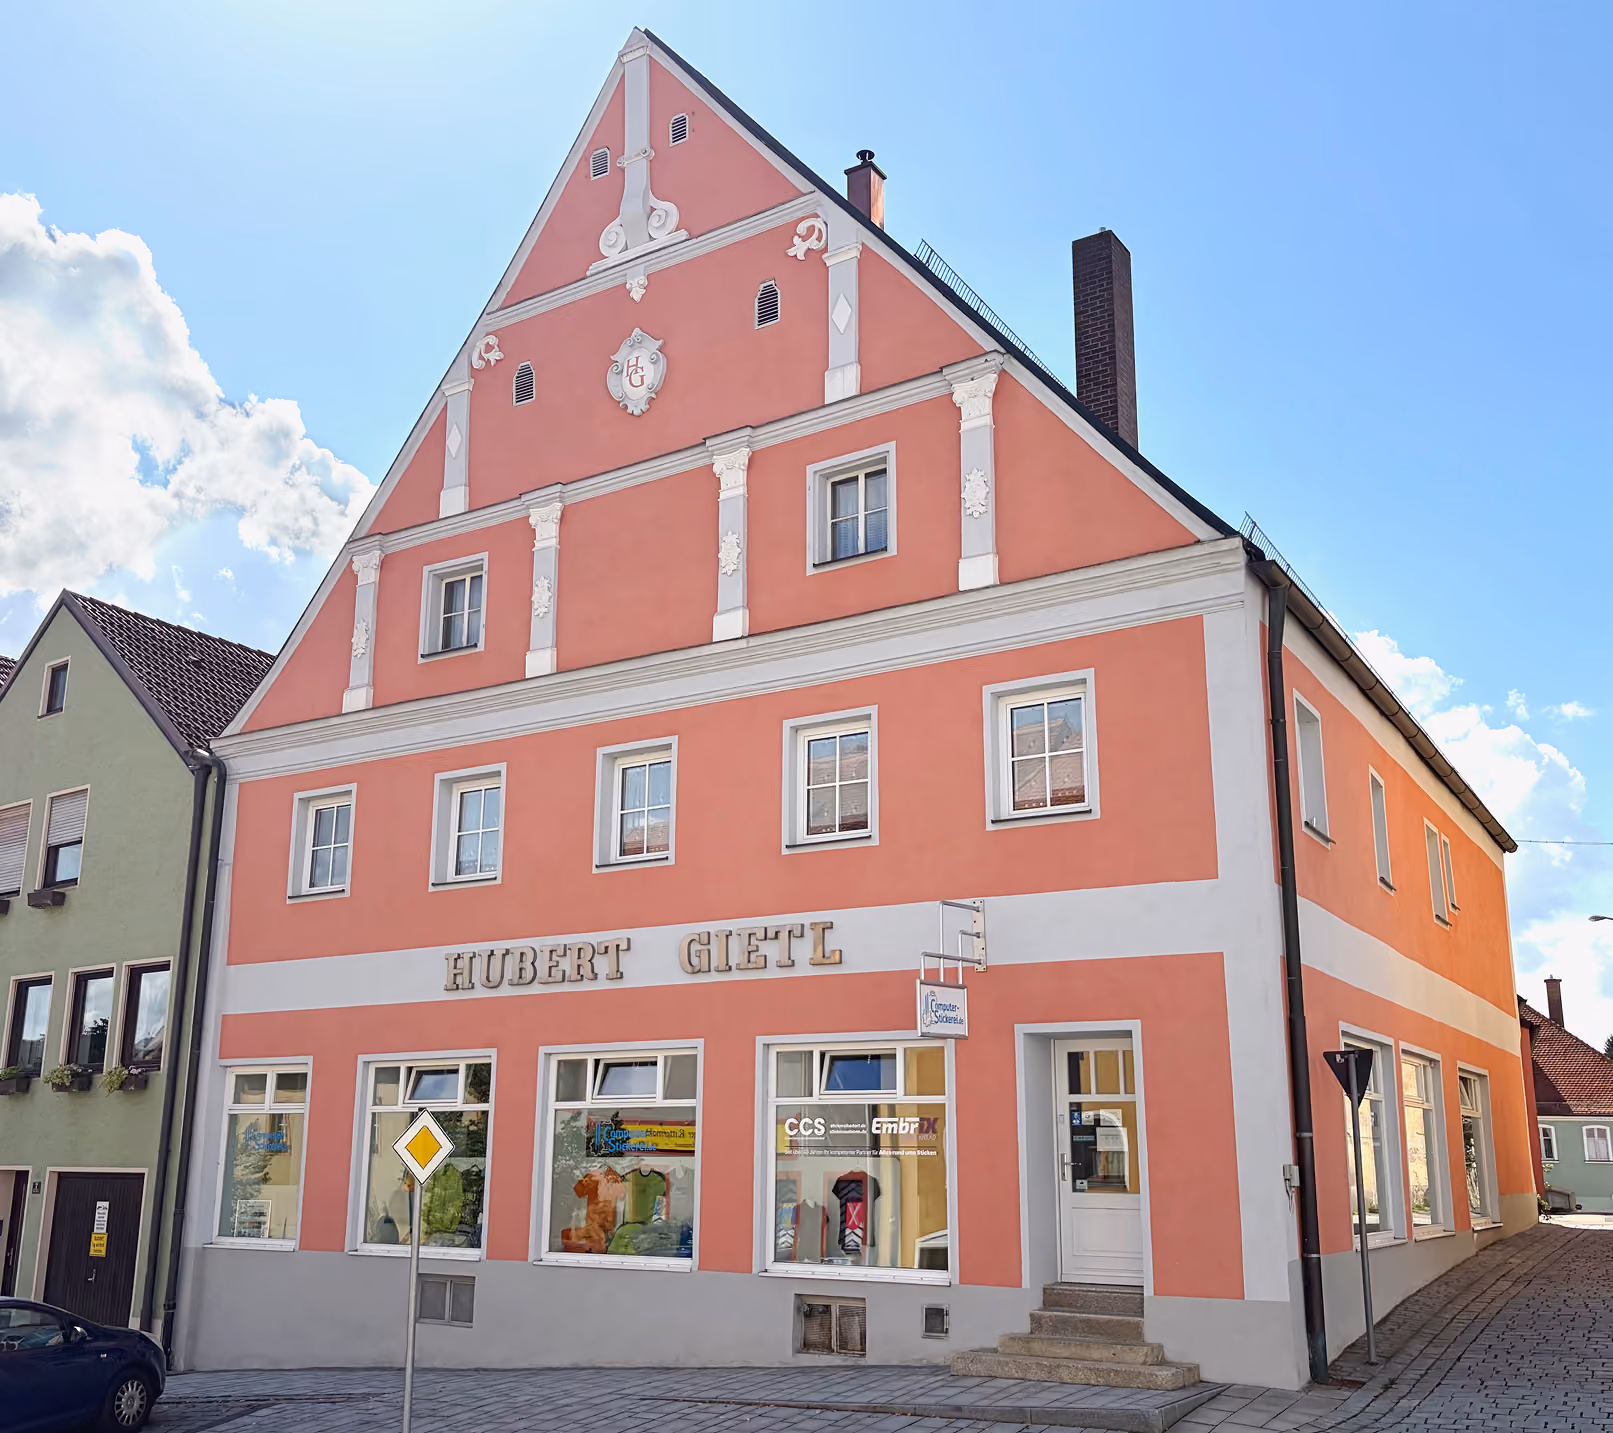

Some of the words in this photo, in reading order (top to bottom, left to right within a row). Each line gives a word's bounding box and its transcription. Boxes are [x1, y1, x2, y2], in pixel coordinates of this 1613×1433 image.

[444, 937, 631, 991] HUBERT
[678, 921, 842, 975] GIETL
[785, 1117, 826, 1135] CCS
